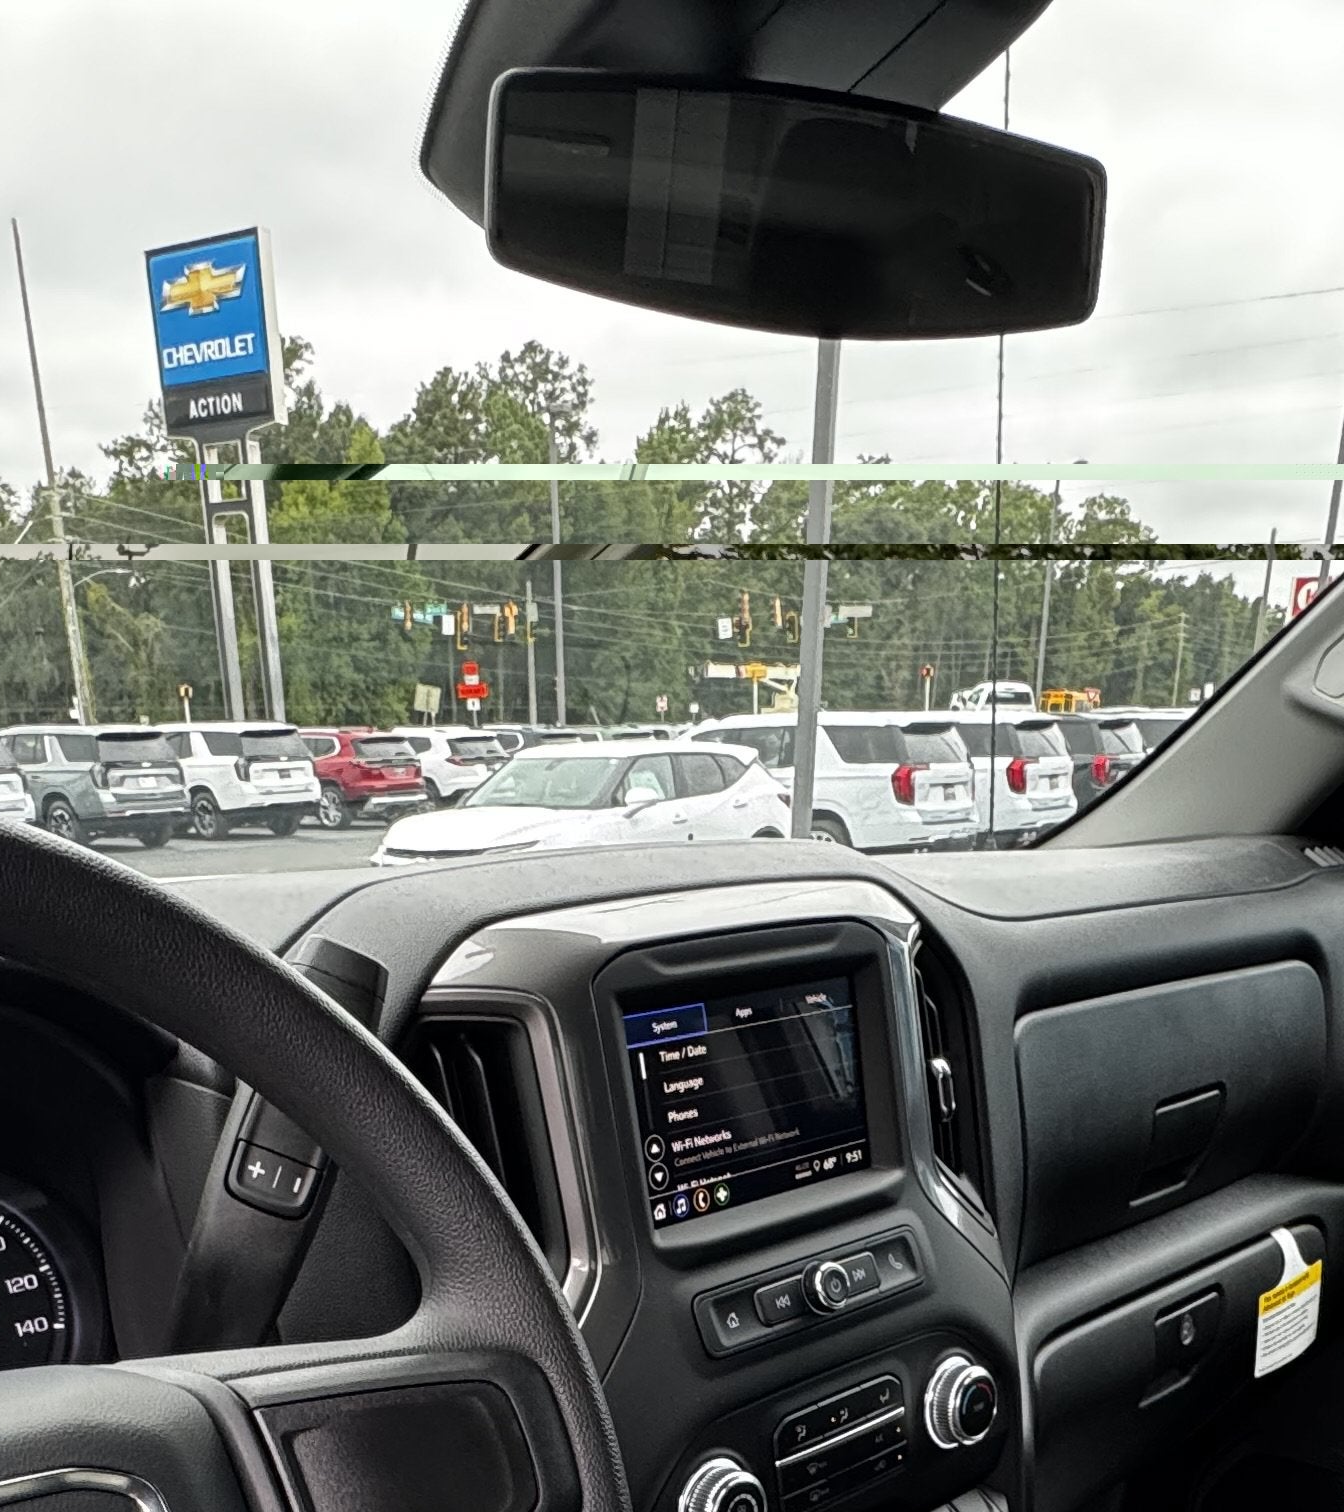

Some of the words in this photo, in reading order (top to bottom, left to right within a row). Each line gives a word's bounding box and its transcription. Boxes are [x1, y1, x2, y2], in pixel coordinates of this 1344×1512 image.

[162, 333, 255, 369] CHEVROLET
[189, 392, 244, 419] ACTION
[651, 1019, 678, 1034] System
[735, 1007, 753, 1018] Apps
[659, 1050, 680, 1062] Time
[686, 1044, 707, 1057] Date
[663, 1077, 704, 1094] Language
[667, 1108, 699, 1123] Phones
[671, 1138, 694, 1153] Wi-Fi
[693, 1130, 732, 1147] Networks
[4, 1274, 38, 1294] 120
[14, 1317, 49, 1338] 140
